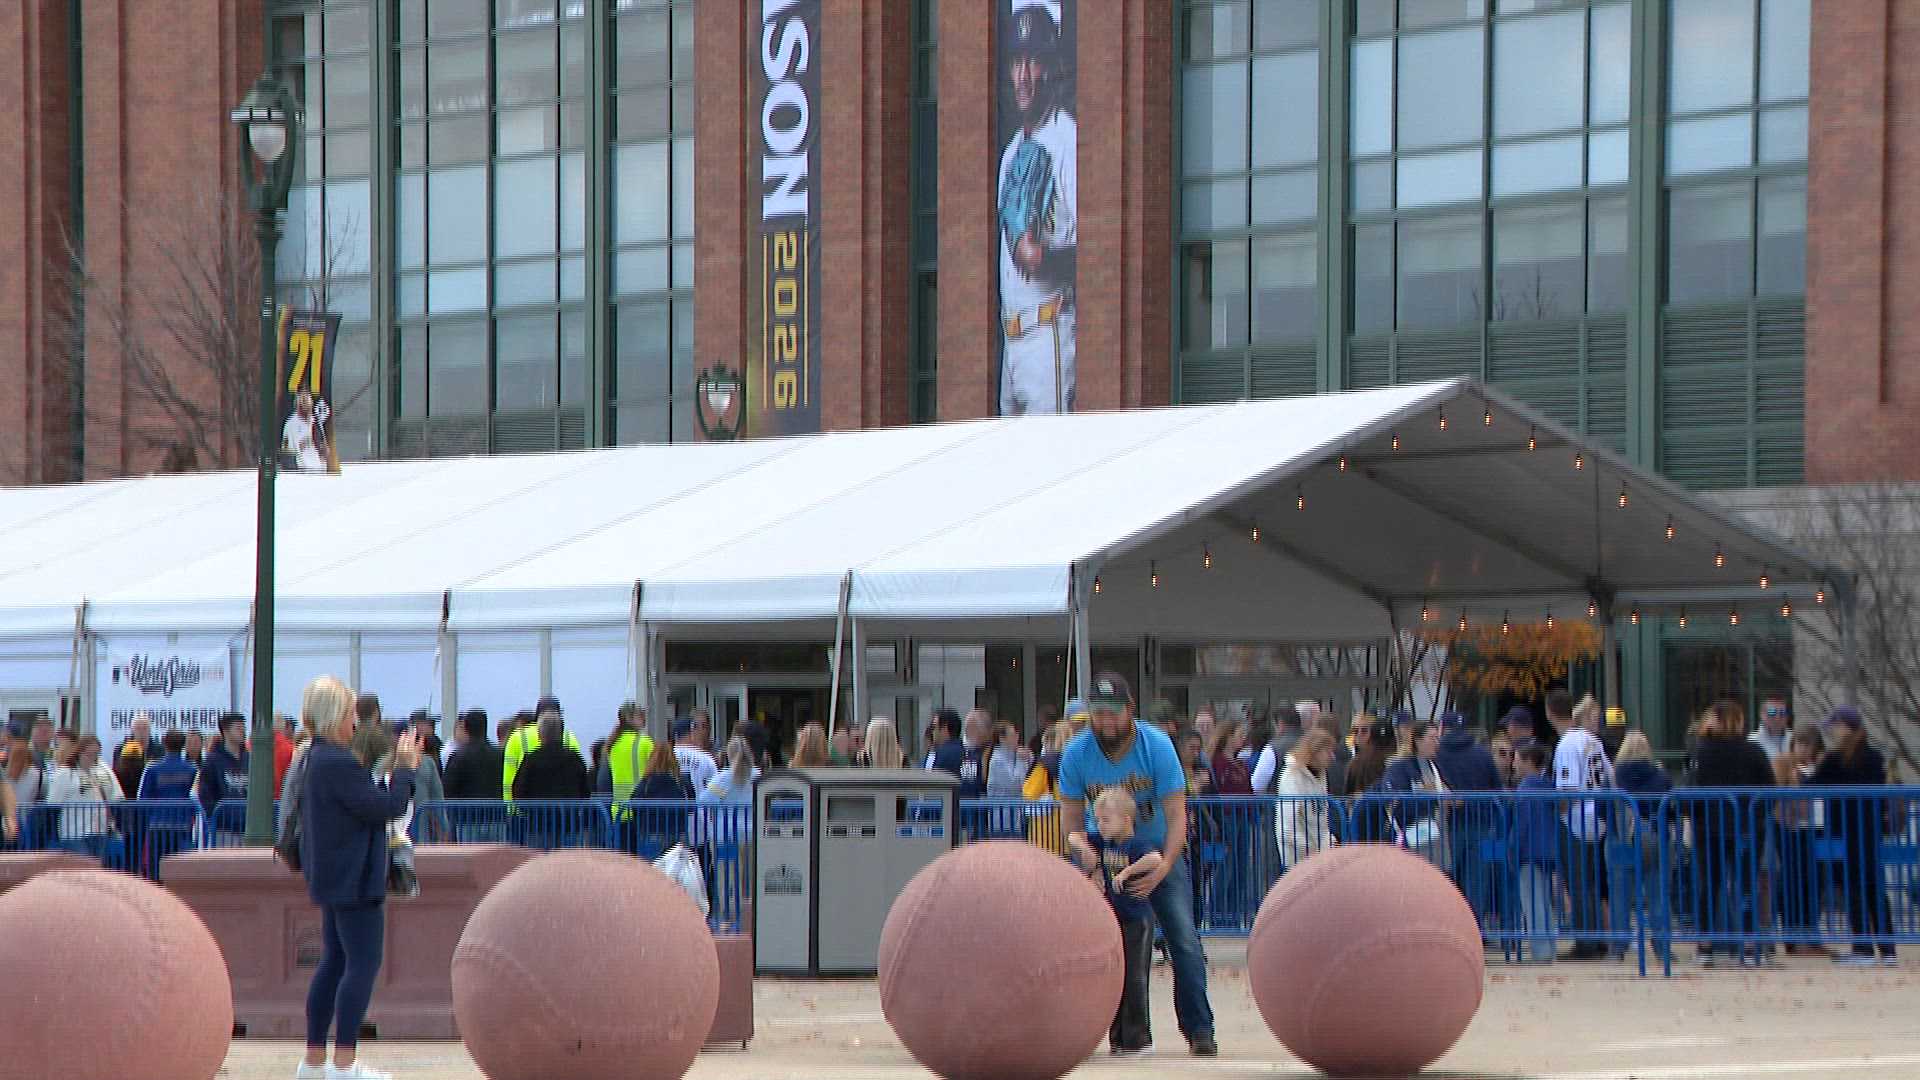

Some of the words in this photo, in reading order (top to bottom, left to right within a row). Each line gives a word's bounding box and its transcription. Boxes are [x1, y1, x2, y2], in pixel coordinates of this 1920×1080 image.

[773, 231, 798, 411] 2026
[287, 329, 326, 395] 21
[130, 653, 167, 688] World
[163, 654, 200, 695] Series
[111, 709, 177, 729] CHAPION
